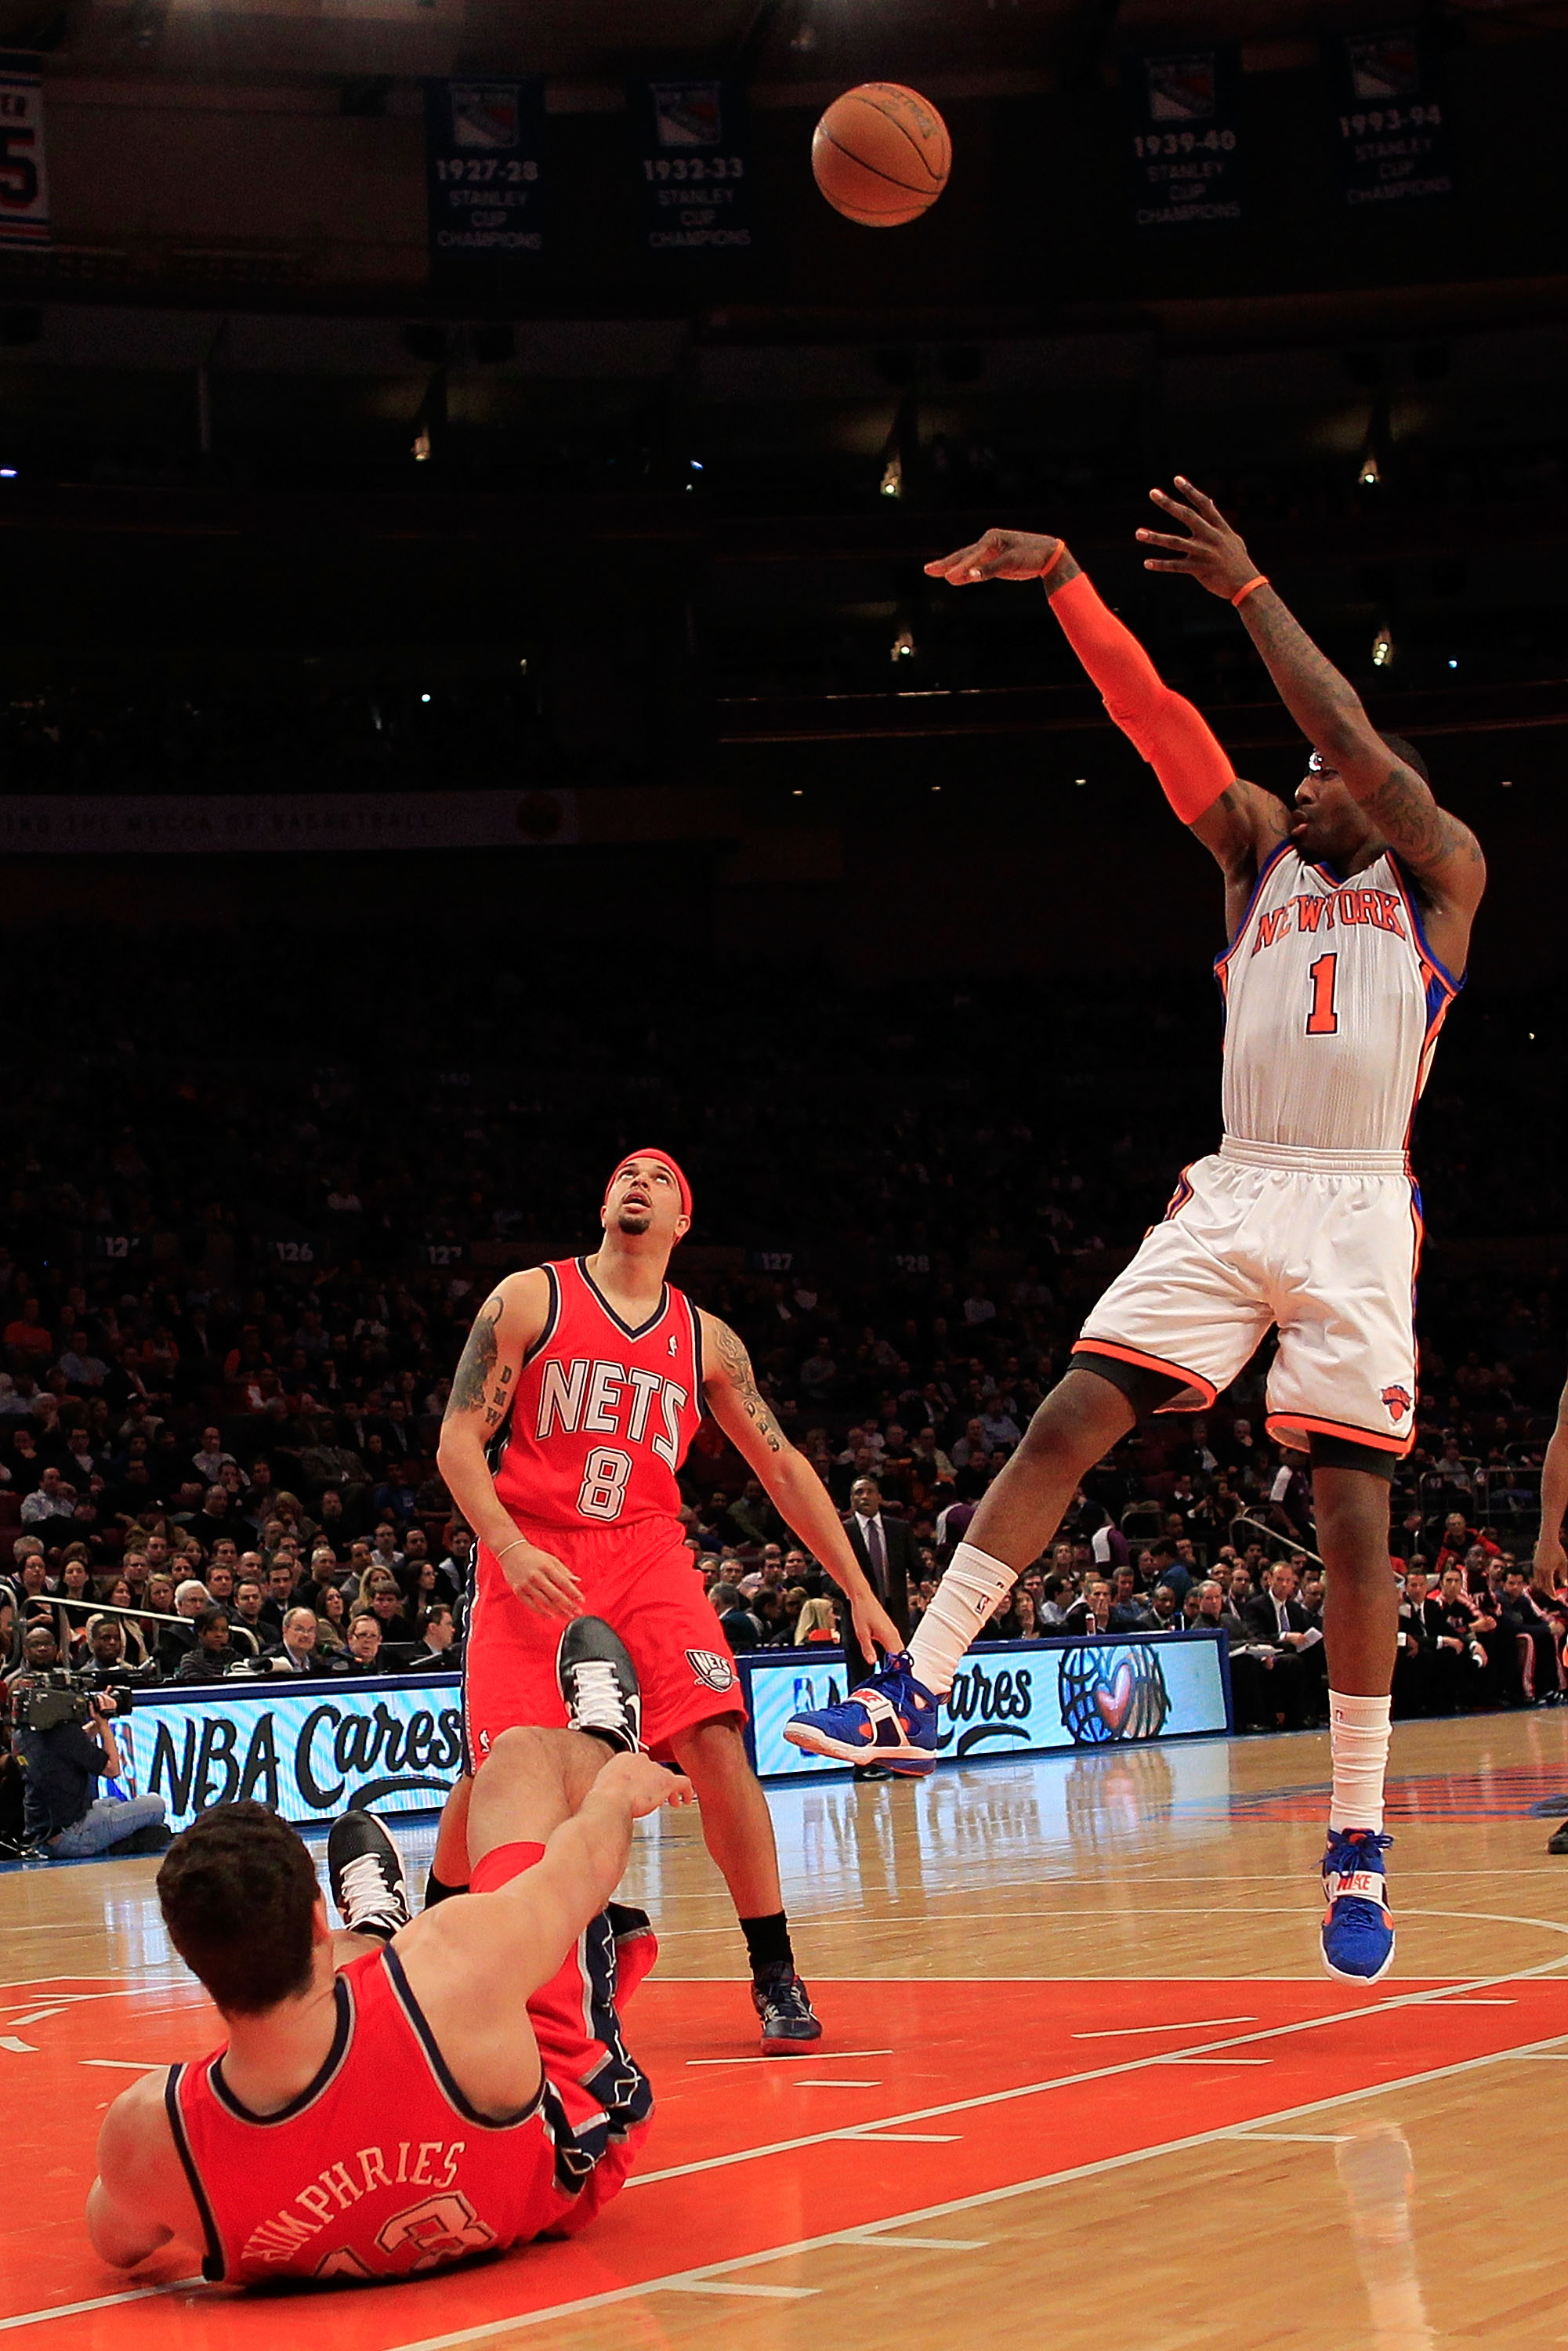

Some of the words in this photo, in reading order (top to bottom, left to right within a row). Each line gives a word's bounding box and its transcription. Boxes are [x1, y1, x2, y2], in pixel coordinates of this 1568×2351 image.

[1339, 103, 1442, 138] 1993-94
[1134, 129, 1237, 158] 1939-40
[1354, 138, 1432, 162] STANLEY
[436, 158, 539, 182] 1927-28
[643, 157, 744, 181] 1932-33
[1146, 161, 1224, 182] STANLEY
[1378, 160, 1414, 179] CUP
[449, 190, 531, 207] STANLEY
[657, 188, 735, 206] STANLEY
[1169, 182, 1207, 201] CUP
[1345, 177, 1453, 205] CHAMPIONS
[470, 210, 508, 227] CUP
[679, 208, 716, 226] CUP
[1135, 201, 1242, 225] CHAMPIONS
[436, 230, 543, 250] CHAMPIONS
[647, 228, 752, 248] CHAMPIONS
[1251, 895, 1325, 959] NEW
[1326, 889, 1407, 941] YORK
[1305, 952, 1338, 1036] 1
[276, 1241, 313, 1262] 126
[536, 1359, 688, 1476] NETS
[576, 1446, 632, 1522] 8
[693, 1652, 731, 1675] NETS
[939, 1663, 1031, 1724] ares
[148, 1712, 281, 1817] NBA
[295, 1703, 462, 1809] Cares
